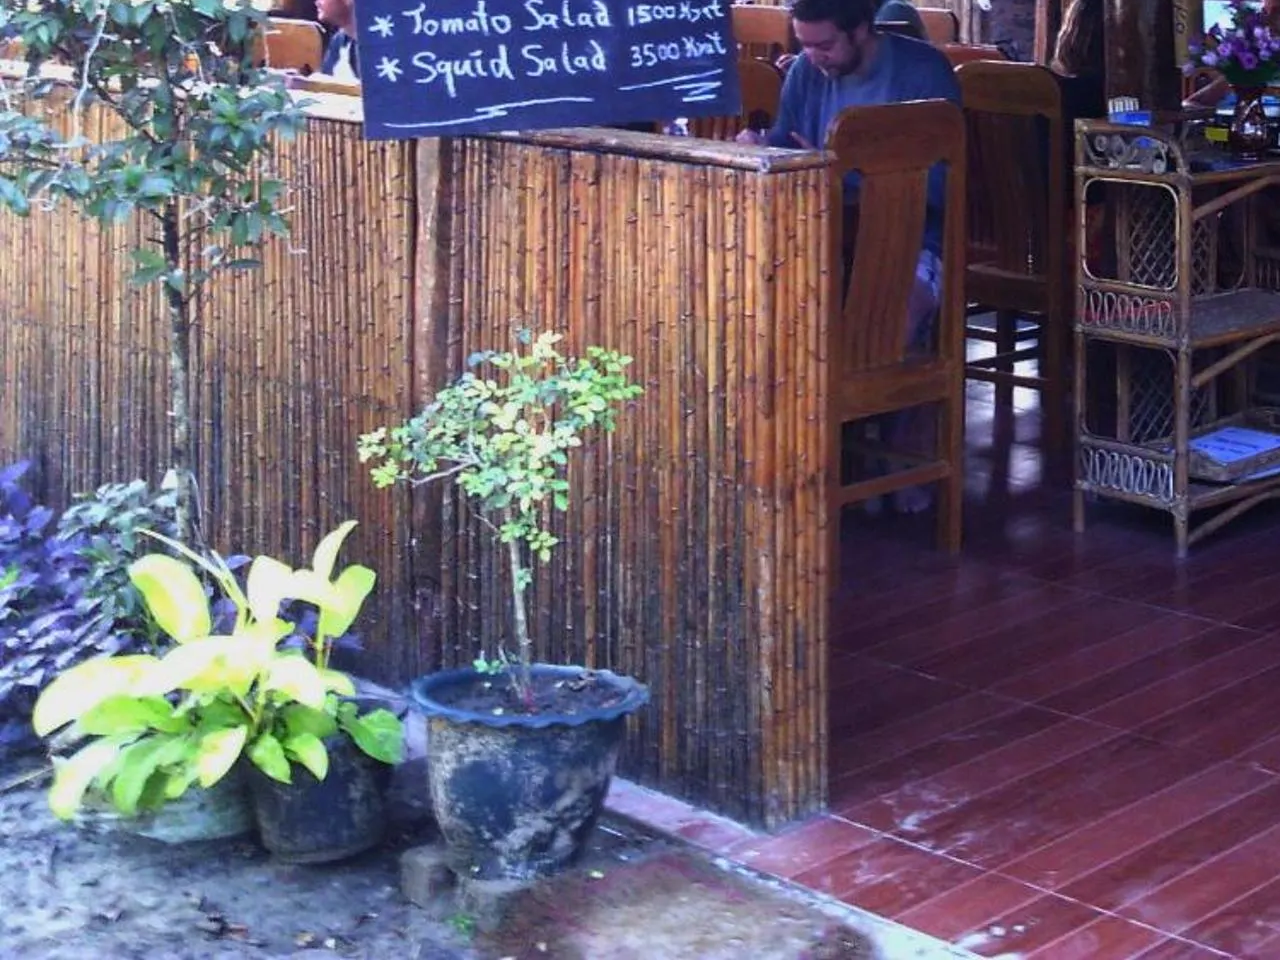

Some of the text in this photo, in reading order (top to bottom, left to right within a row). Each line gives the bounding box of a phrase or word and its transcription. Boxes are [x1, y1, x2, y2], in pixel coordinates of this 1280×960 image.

[402, 0, 512, 38] Tomato
[412, 44, 515, 98] Squid
[521, 40, 607, 77] Salad
